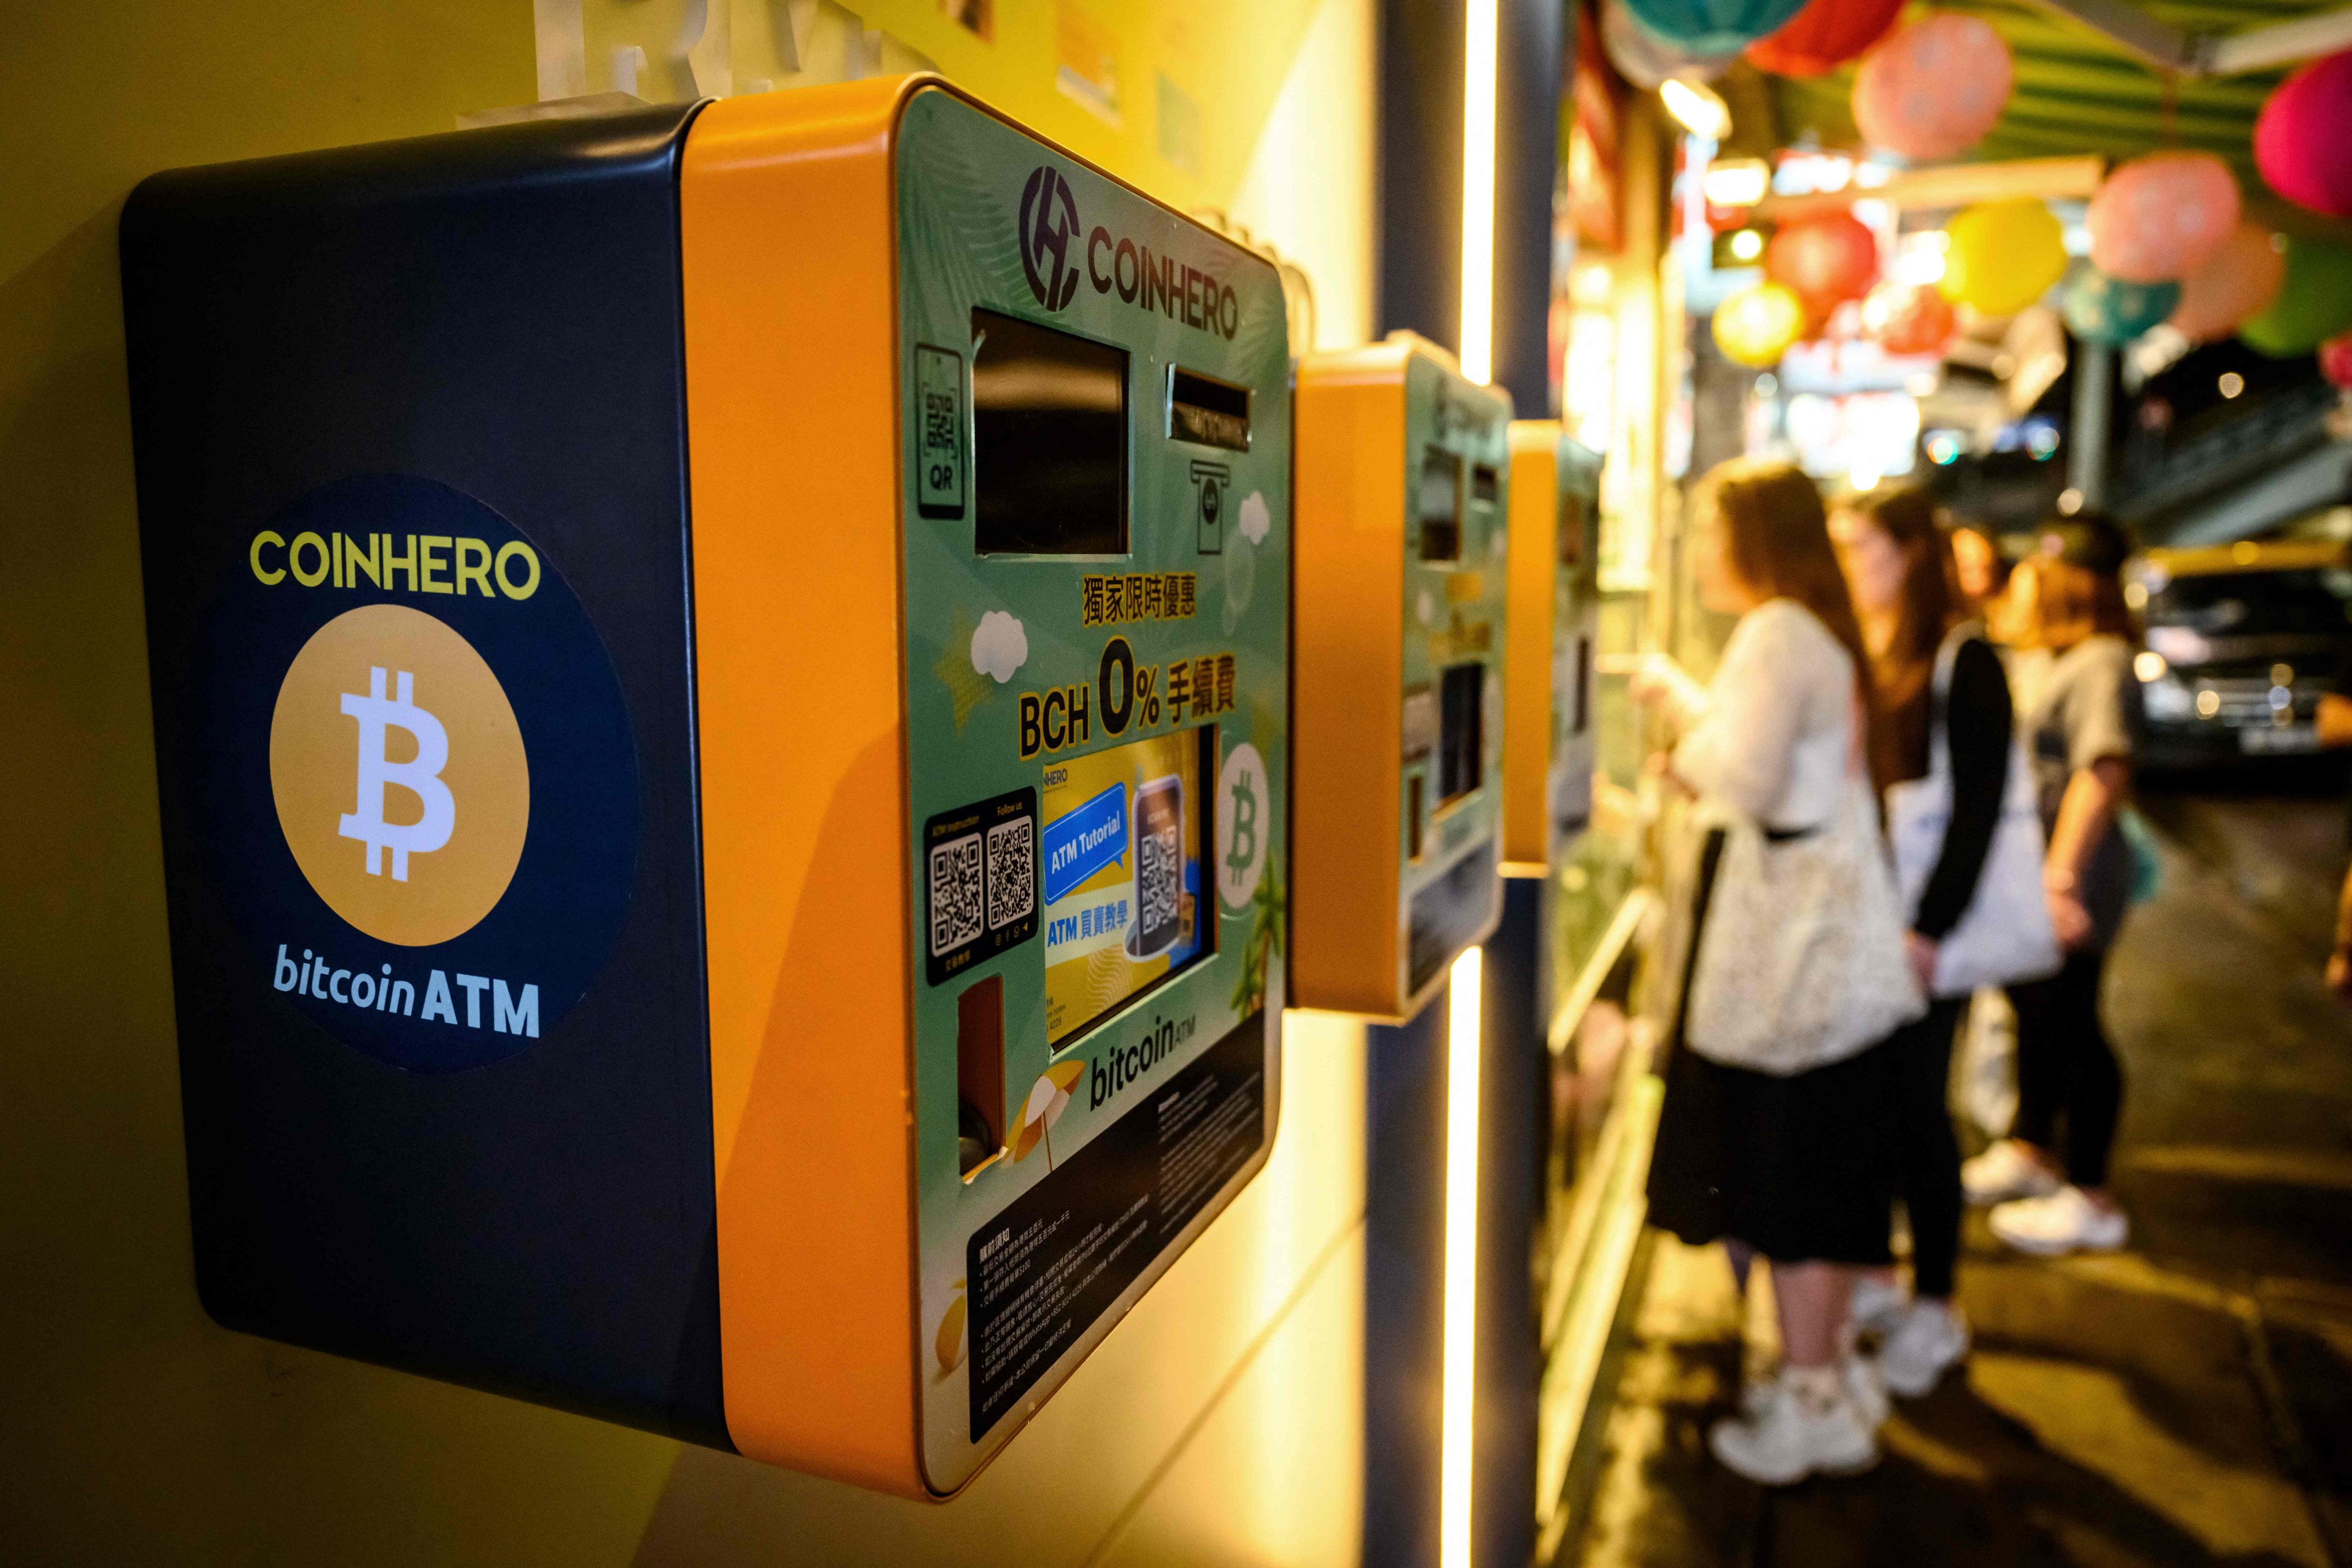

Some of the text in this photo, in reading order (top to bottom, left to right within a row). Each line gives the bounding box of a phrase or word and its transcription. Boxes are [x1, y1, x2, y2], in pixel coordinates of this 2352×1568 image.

[1088, 226, 1237, 341] COINHERO
[930, 464, 953, 489] QR
[250, 530, 540, 600] COINHERO
[1083, 573, 1195, 625] 獨家限時優惠
[1021, 686, 1088, 758] BCH
[1167, 655, 1234, 724] 手續費
[997, 804, 1015, 816] Follow
[1052, 839, 1077, 874] ATM
[1079, 810, 1121, 855] Tutorial
[1047, 916, 1077, 947] ATM
[273, 944, 539, 1038] bitcoin ATM
[1090, 1015, 1173, 1111] bitcoin
